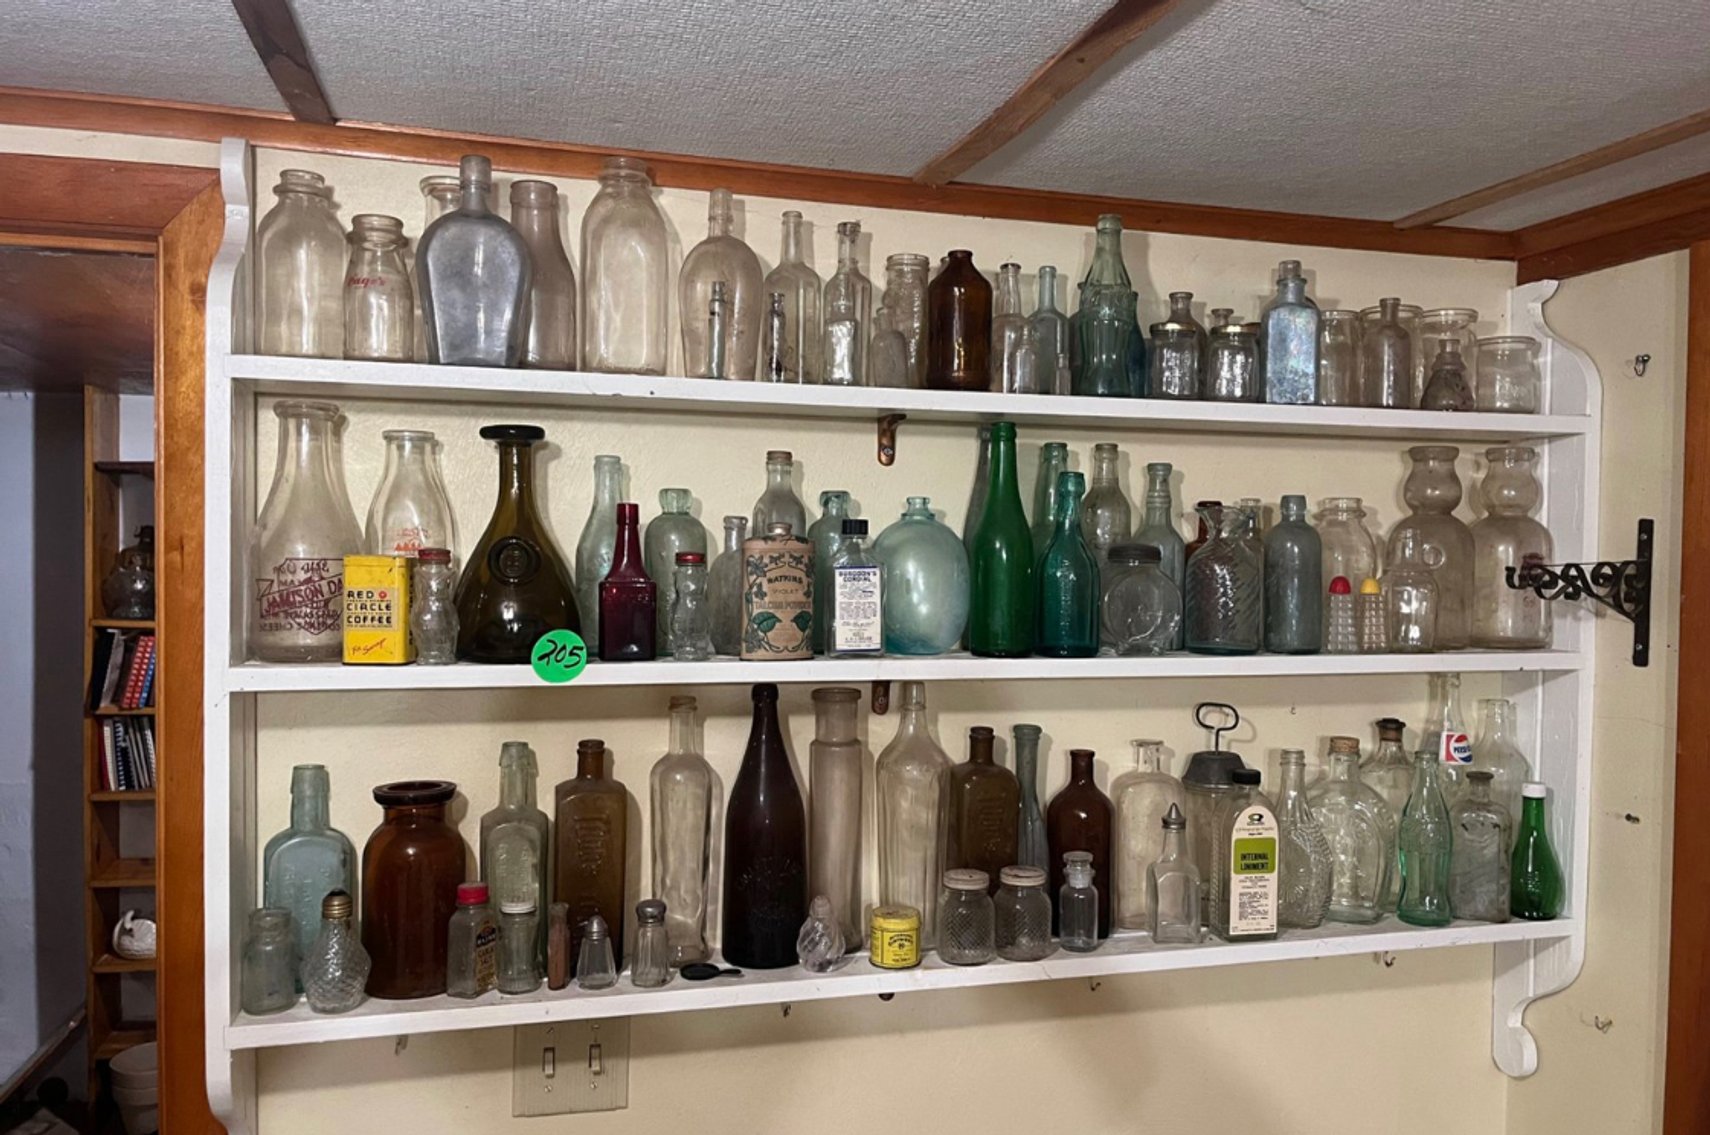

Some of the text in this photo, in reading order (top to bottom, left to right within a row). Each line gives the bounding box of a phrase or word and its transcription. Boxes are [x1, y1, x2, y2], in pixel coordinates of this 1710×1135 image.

[767, 575, 803, 584] WATKINS
[347, 590, 374, 599] RED
[346, 602, 392, 611] CIRCLE
[346, 615, 392, 624] COFFEE
[537, 639, 584, 669] 205
